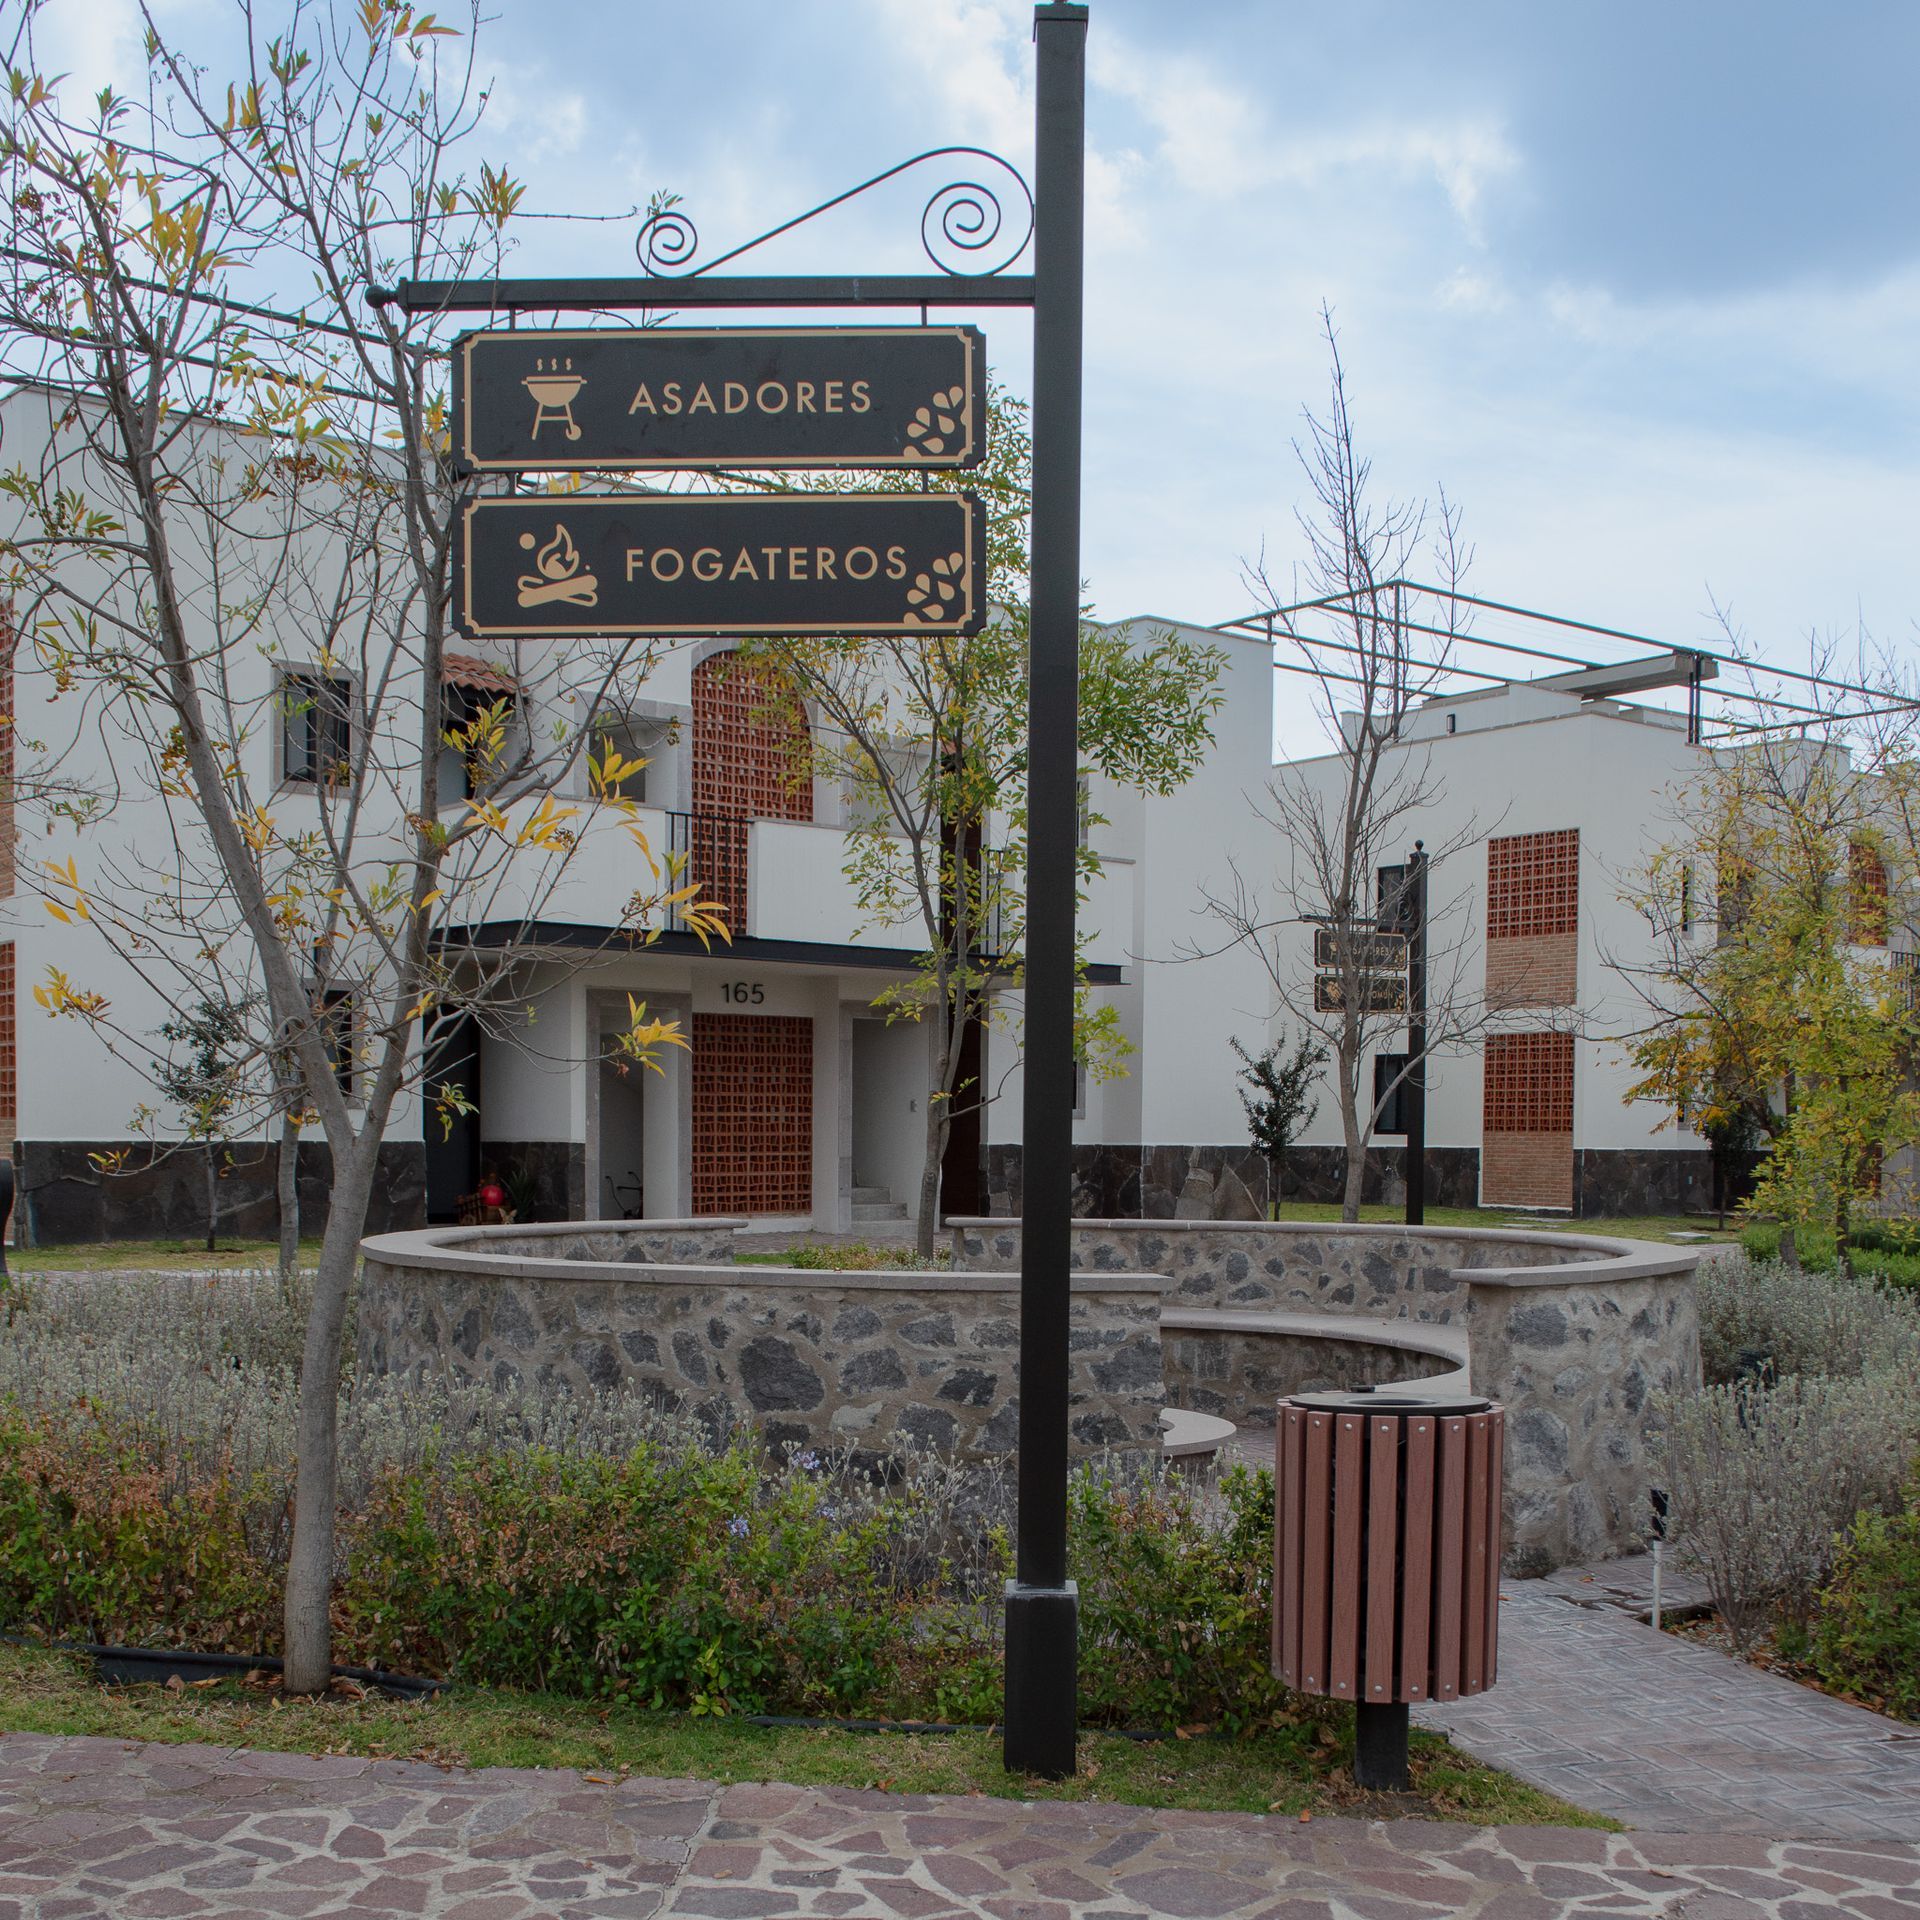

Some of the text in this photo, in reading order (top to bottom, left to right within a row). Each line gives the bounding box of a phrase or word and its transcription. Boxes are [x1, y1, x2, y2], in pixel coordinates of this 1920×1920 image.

[628, 380, 872, 415] ASADORES
[626, 545, 908, 582] FOGATEROS
[720, 982, 765, 1005] 165
